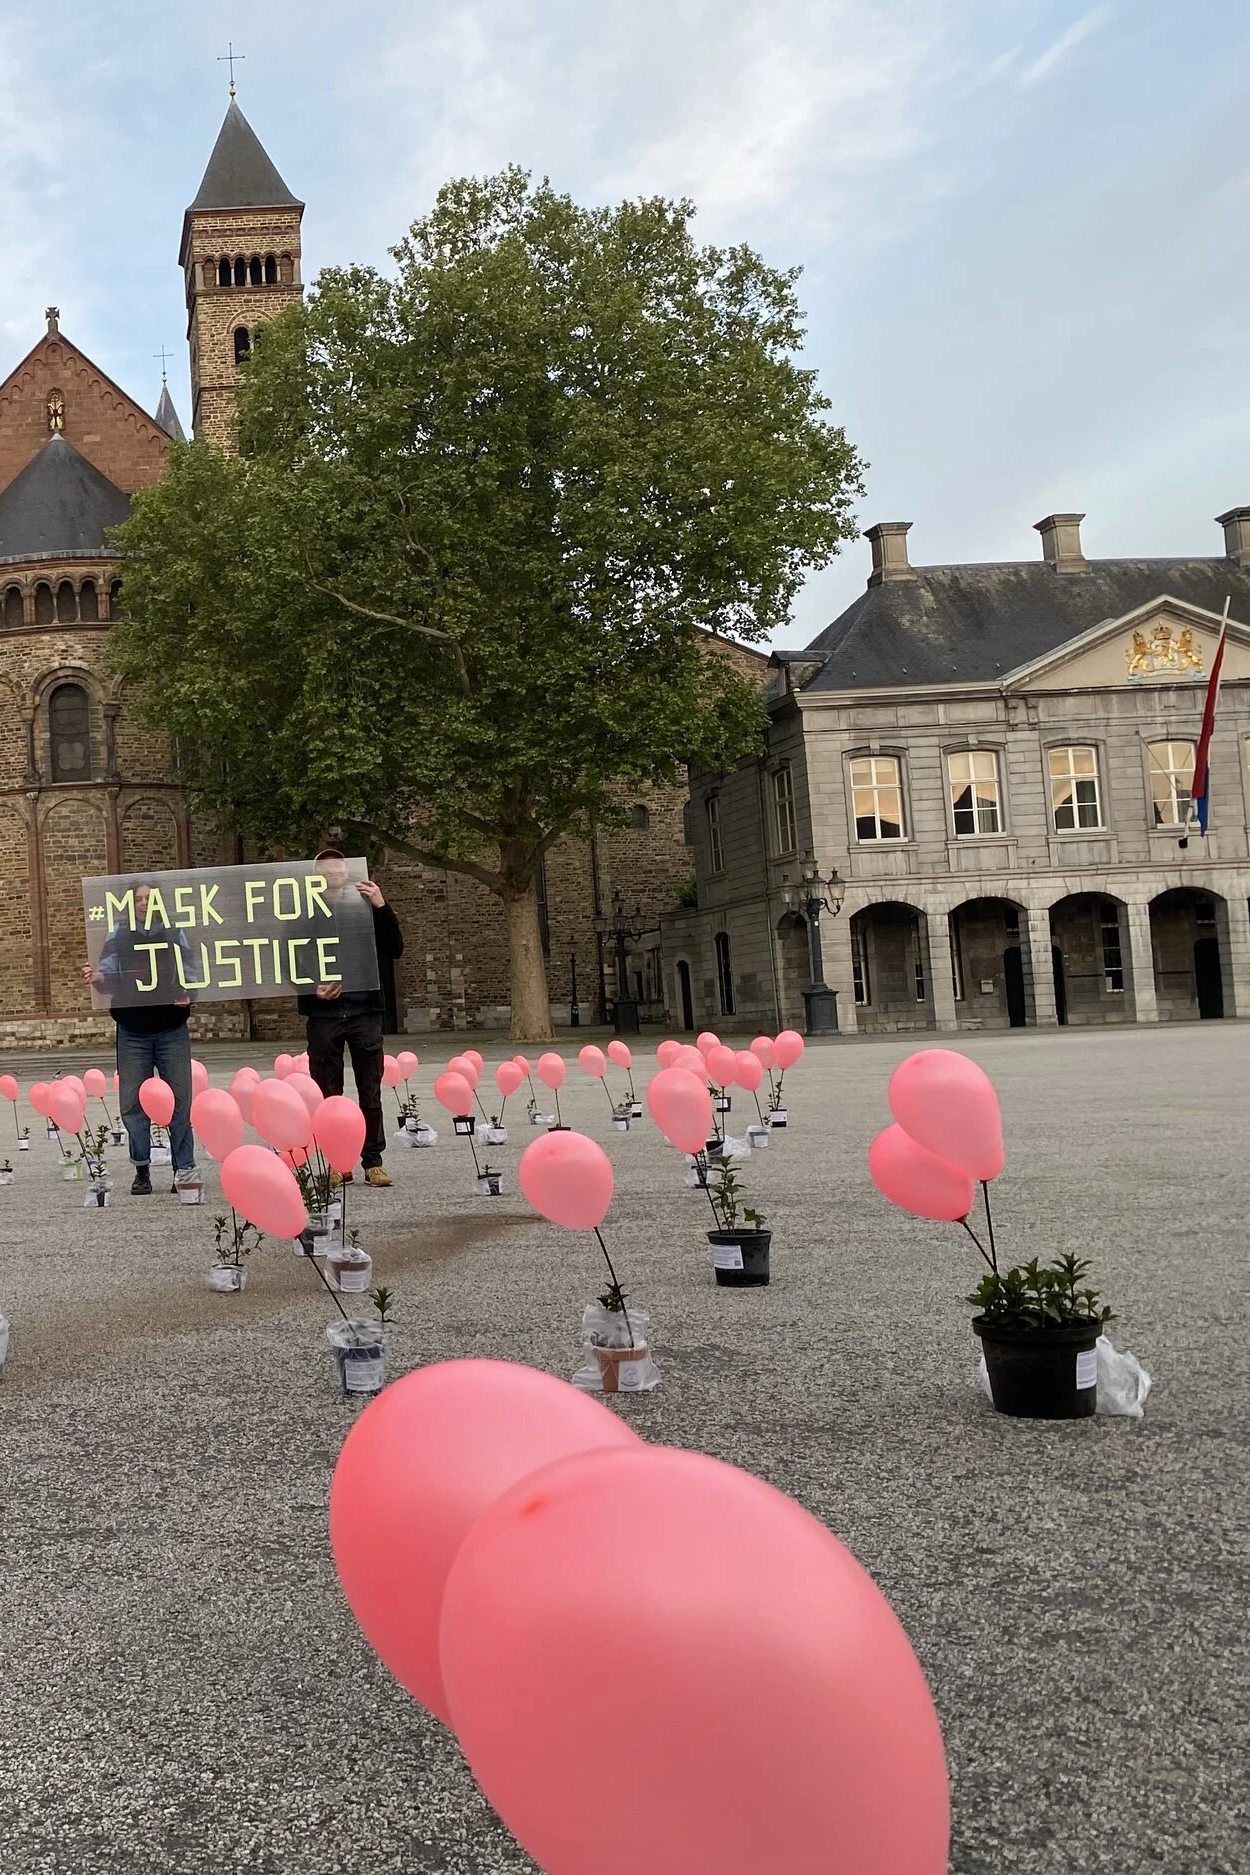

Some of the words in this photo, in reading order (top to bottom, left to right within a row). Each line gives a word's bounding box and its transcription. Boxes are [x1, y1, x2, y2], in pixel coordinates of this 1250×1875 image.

[88, 884, 224, 932] #MASK
[244, 875, 333, 923] FOR
[133, 937, 342, 991] JUSTICE
